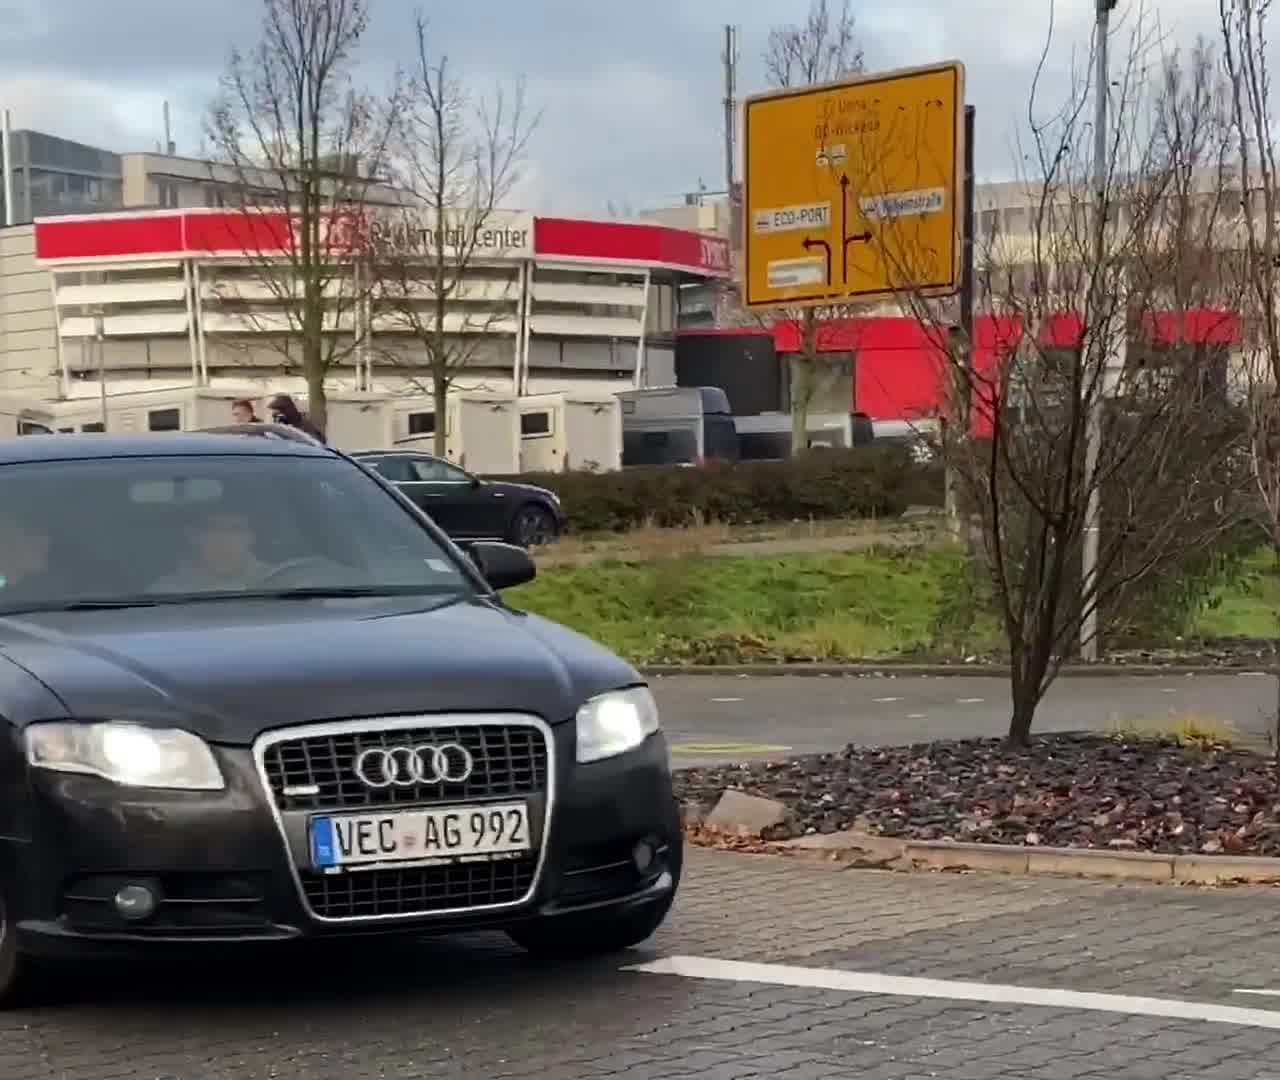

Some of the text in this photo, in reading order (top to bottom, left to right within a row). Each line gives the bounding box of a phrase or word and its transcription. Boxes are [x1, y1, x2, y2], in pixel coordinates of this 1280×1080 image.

[775, 207, 827, 226] ECO-PORT
[474, 224, 528, 248] Center
[335, 809, 524, 857] VEC AG 992
